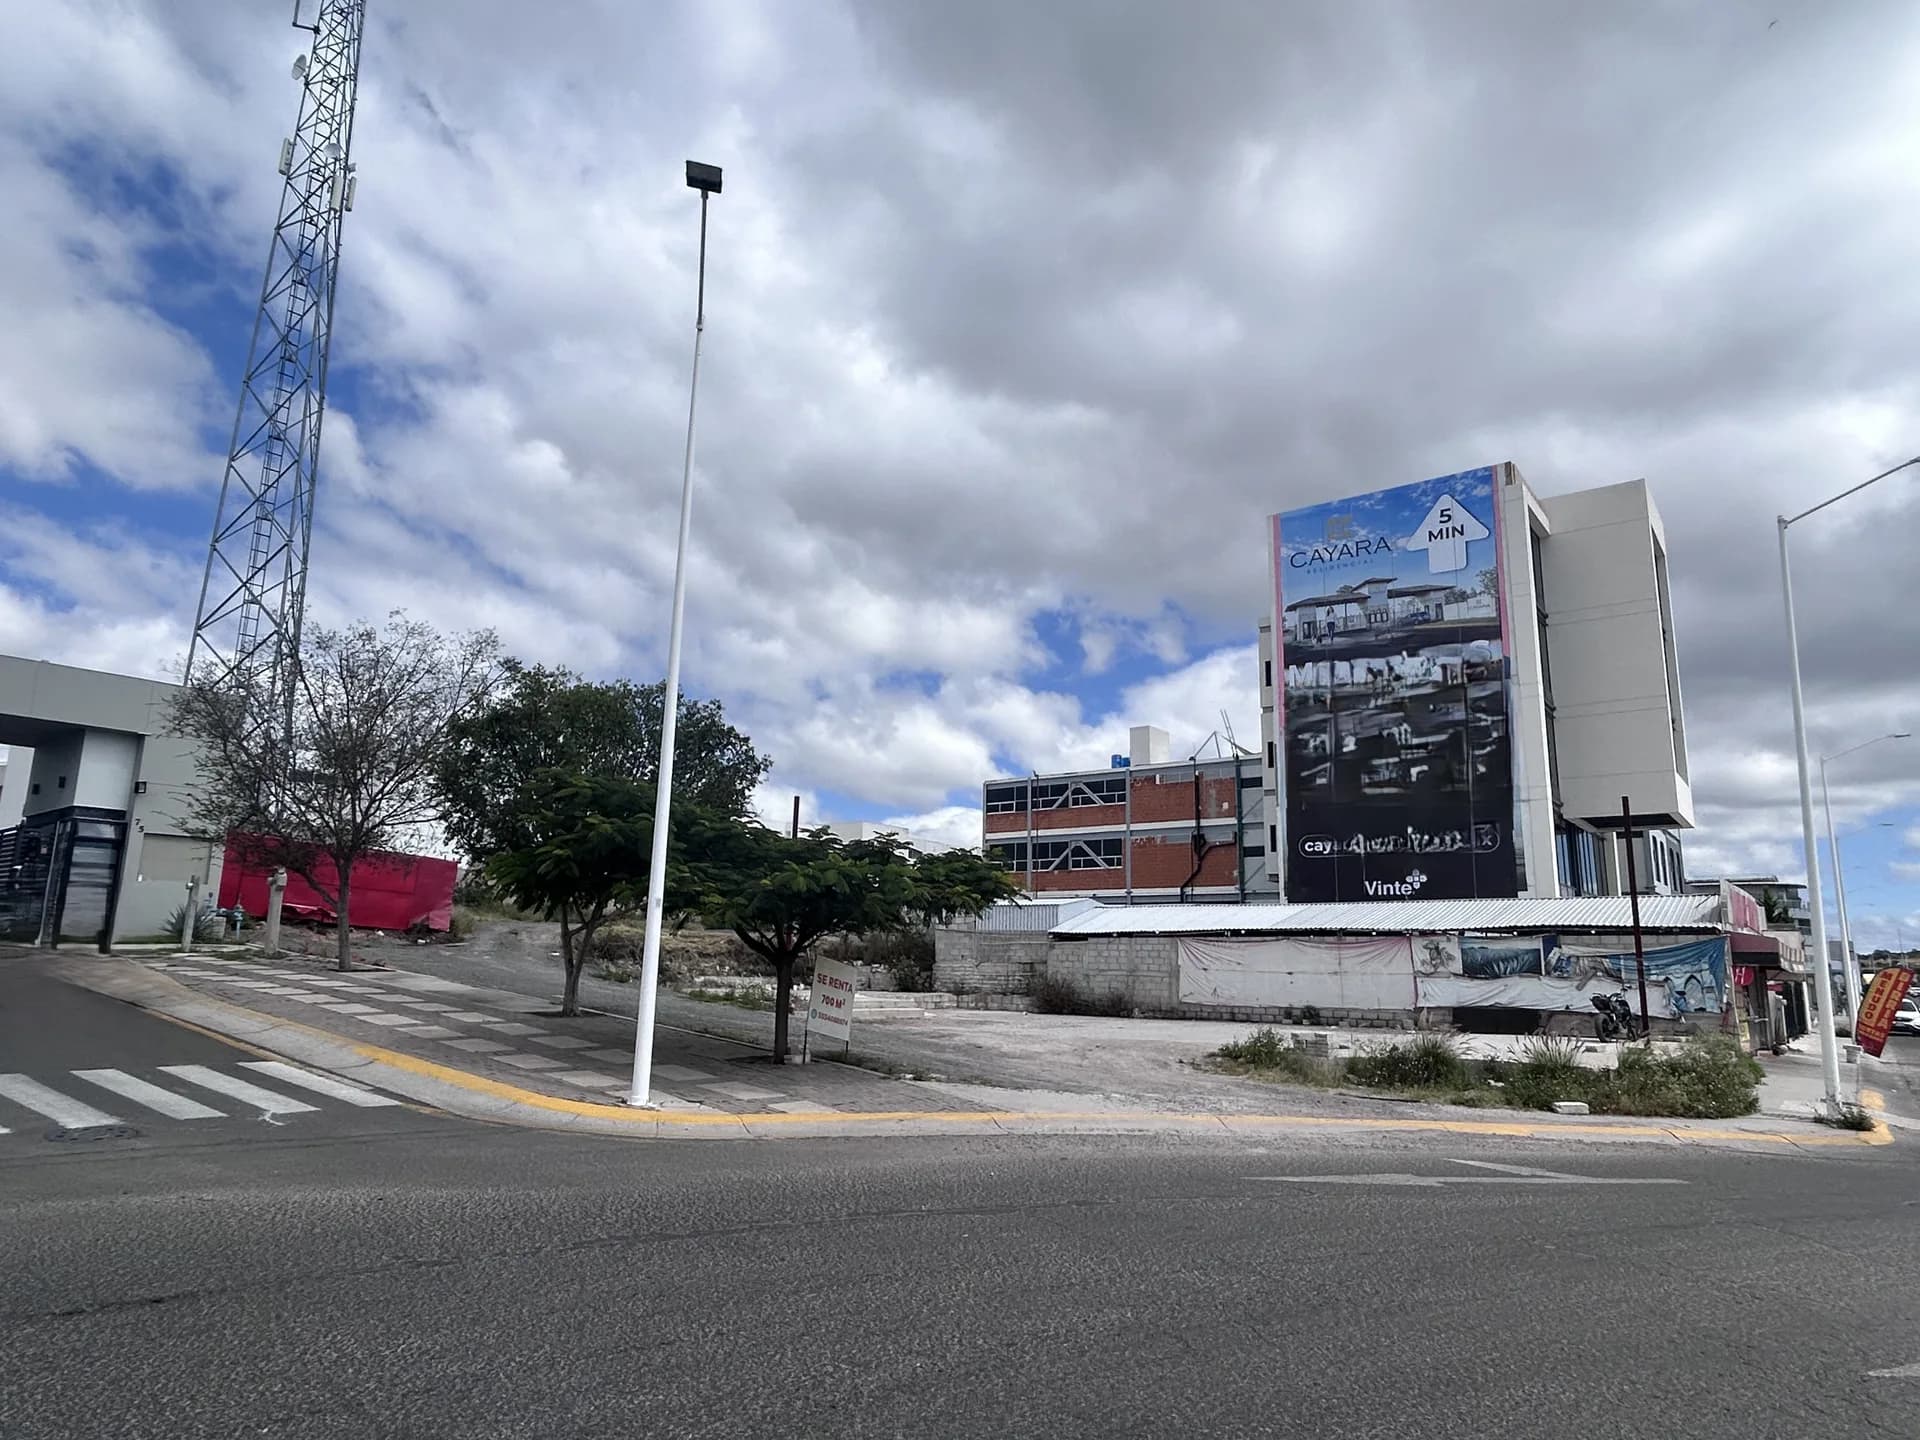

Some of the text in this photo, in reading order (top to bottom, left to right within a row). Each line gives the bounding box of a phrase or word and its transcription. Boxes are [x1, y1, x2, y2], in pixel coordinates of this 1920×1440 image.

[1439, 508, 1452, 524] 5
[1428, 523, 1464, 542] MIN
[1290, 536, 1392, 568] CAYARA
[816, 972, 853, 993] SE RENTA
[821, 994, 834, 1007] 700
[1864, 971, 1893, 1019] MENUDO
